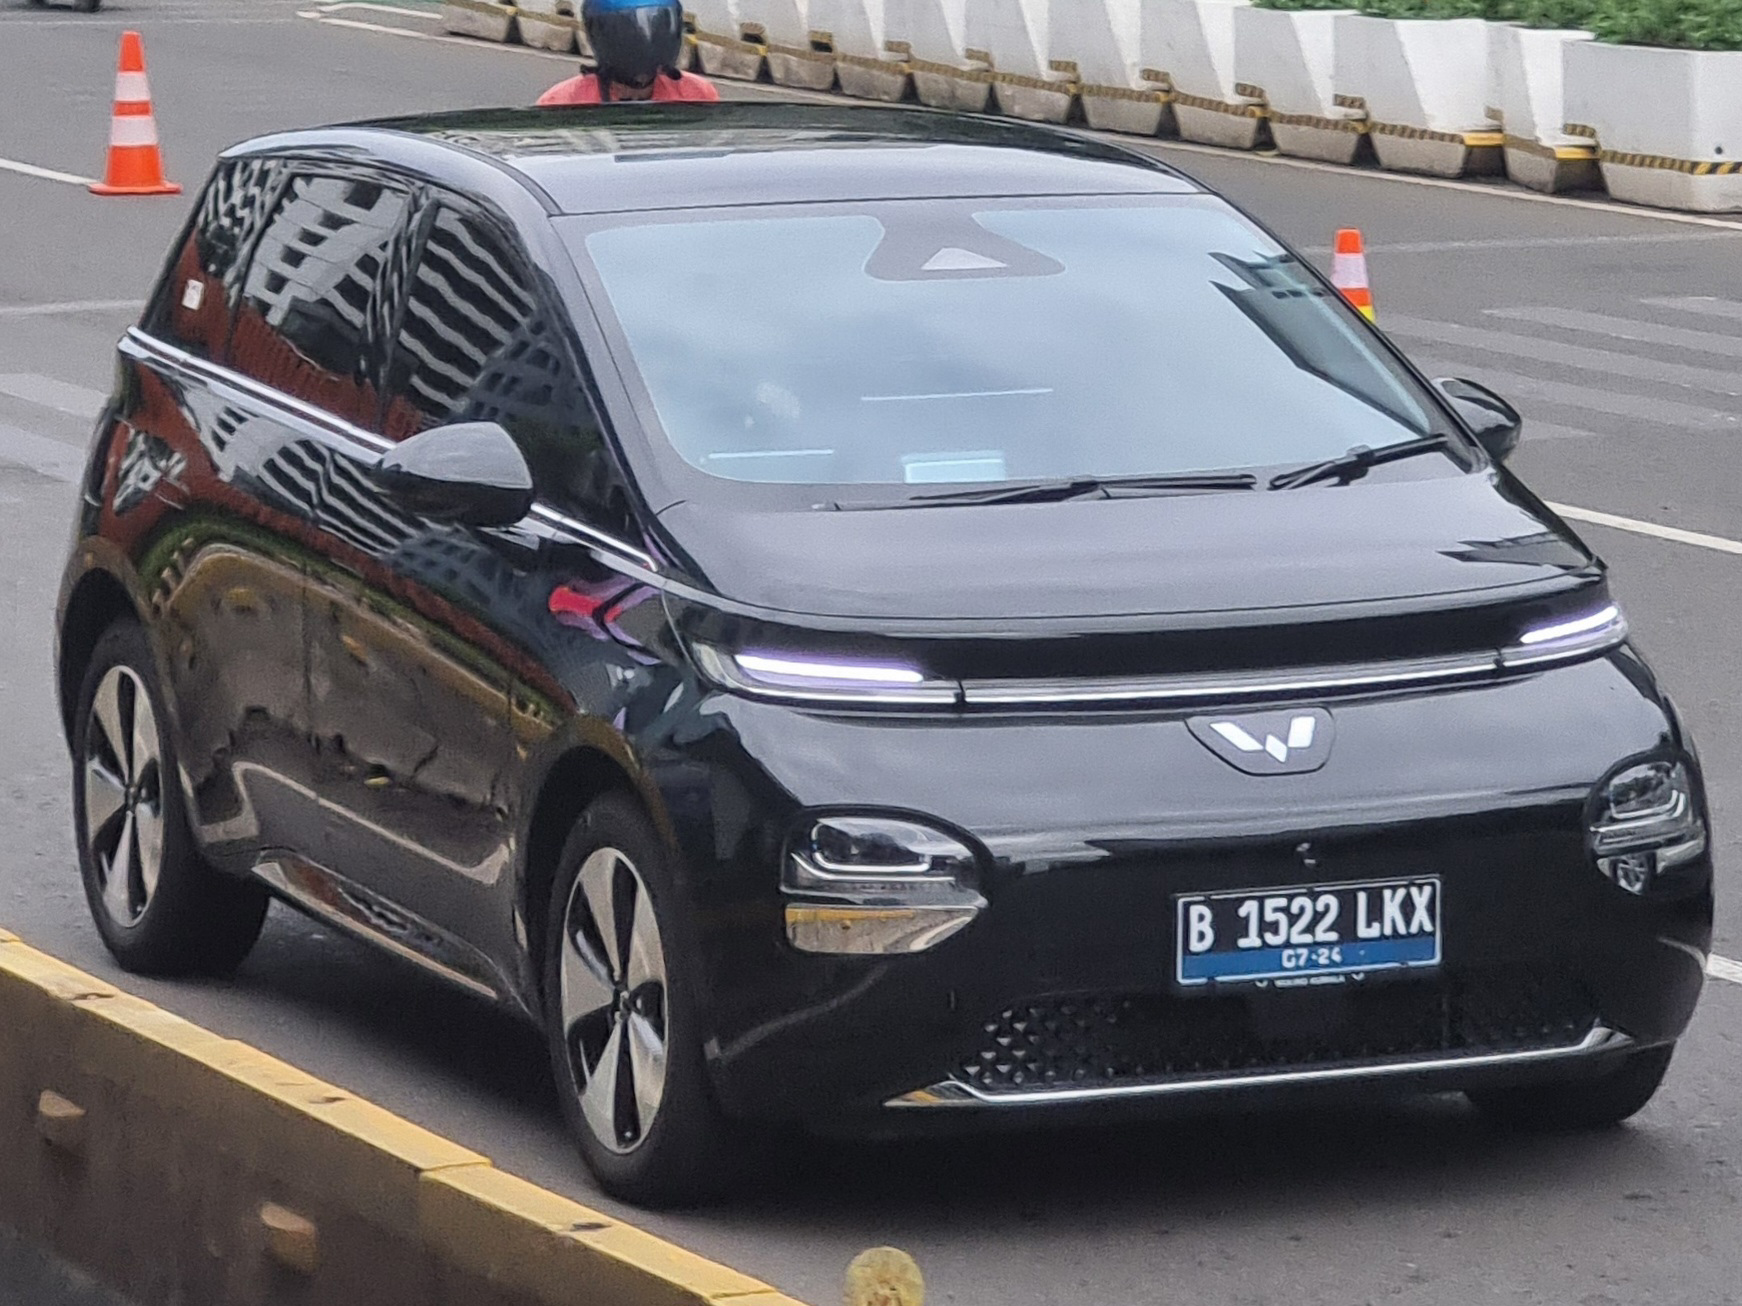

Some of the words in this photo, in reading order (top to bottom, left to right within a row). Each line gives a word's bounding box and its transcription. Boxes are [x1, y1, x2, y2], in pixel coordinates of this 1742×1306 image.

[1189, 905, 1214, 953] B
[1237, 894, 1339, 948] 1522
[1357, 886, 1434, 938] LKX
